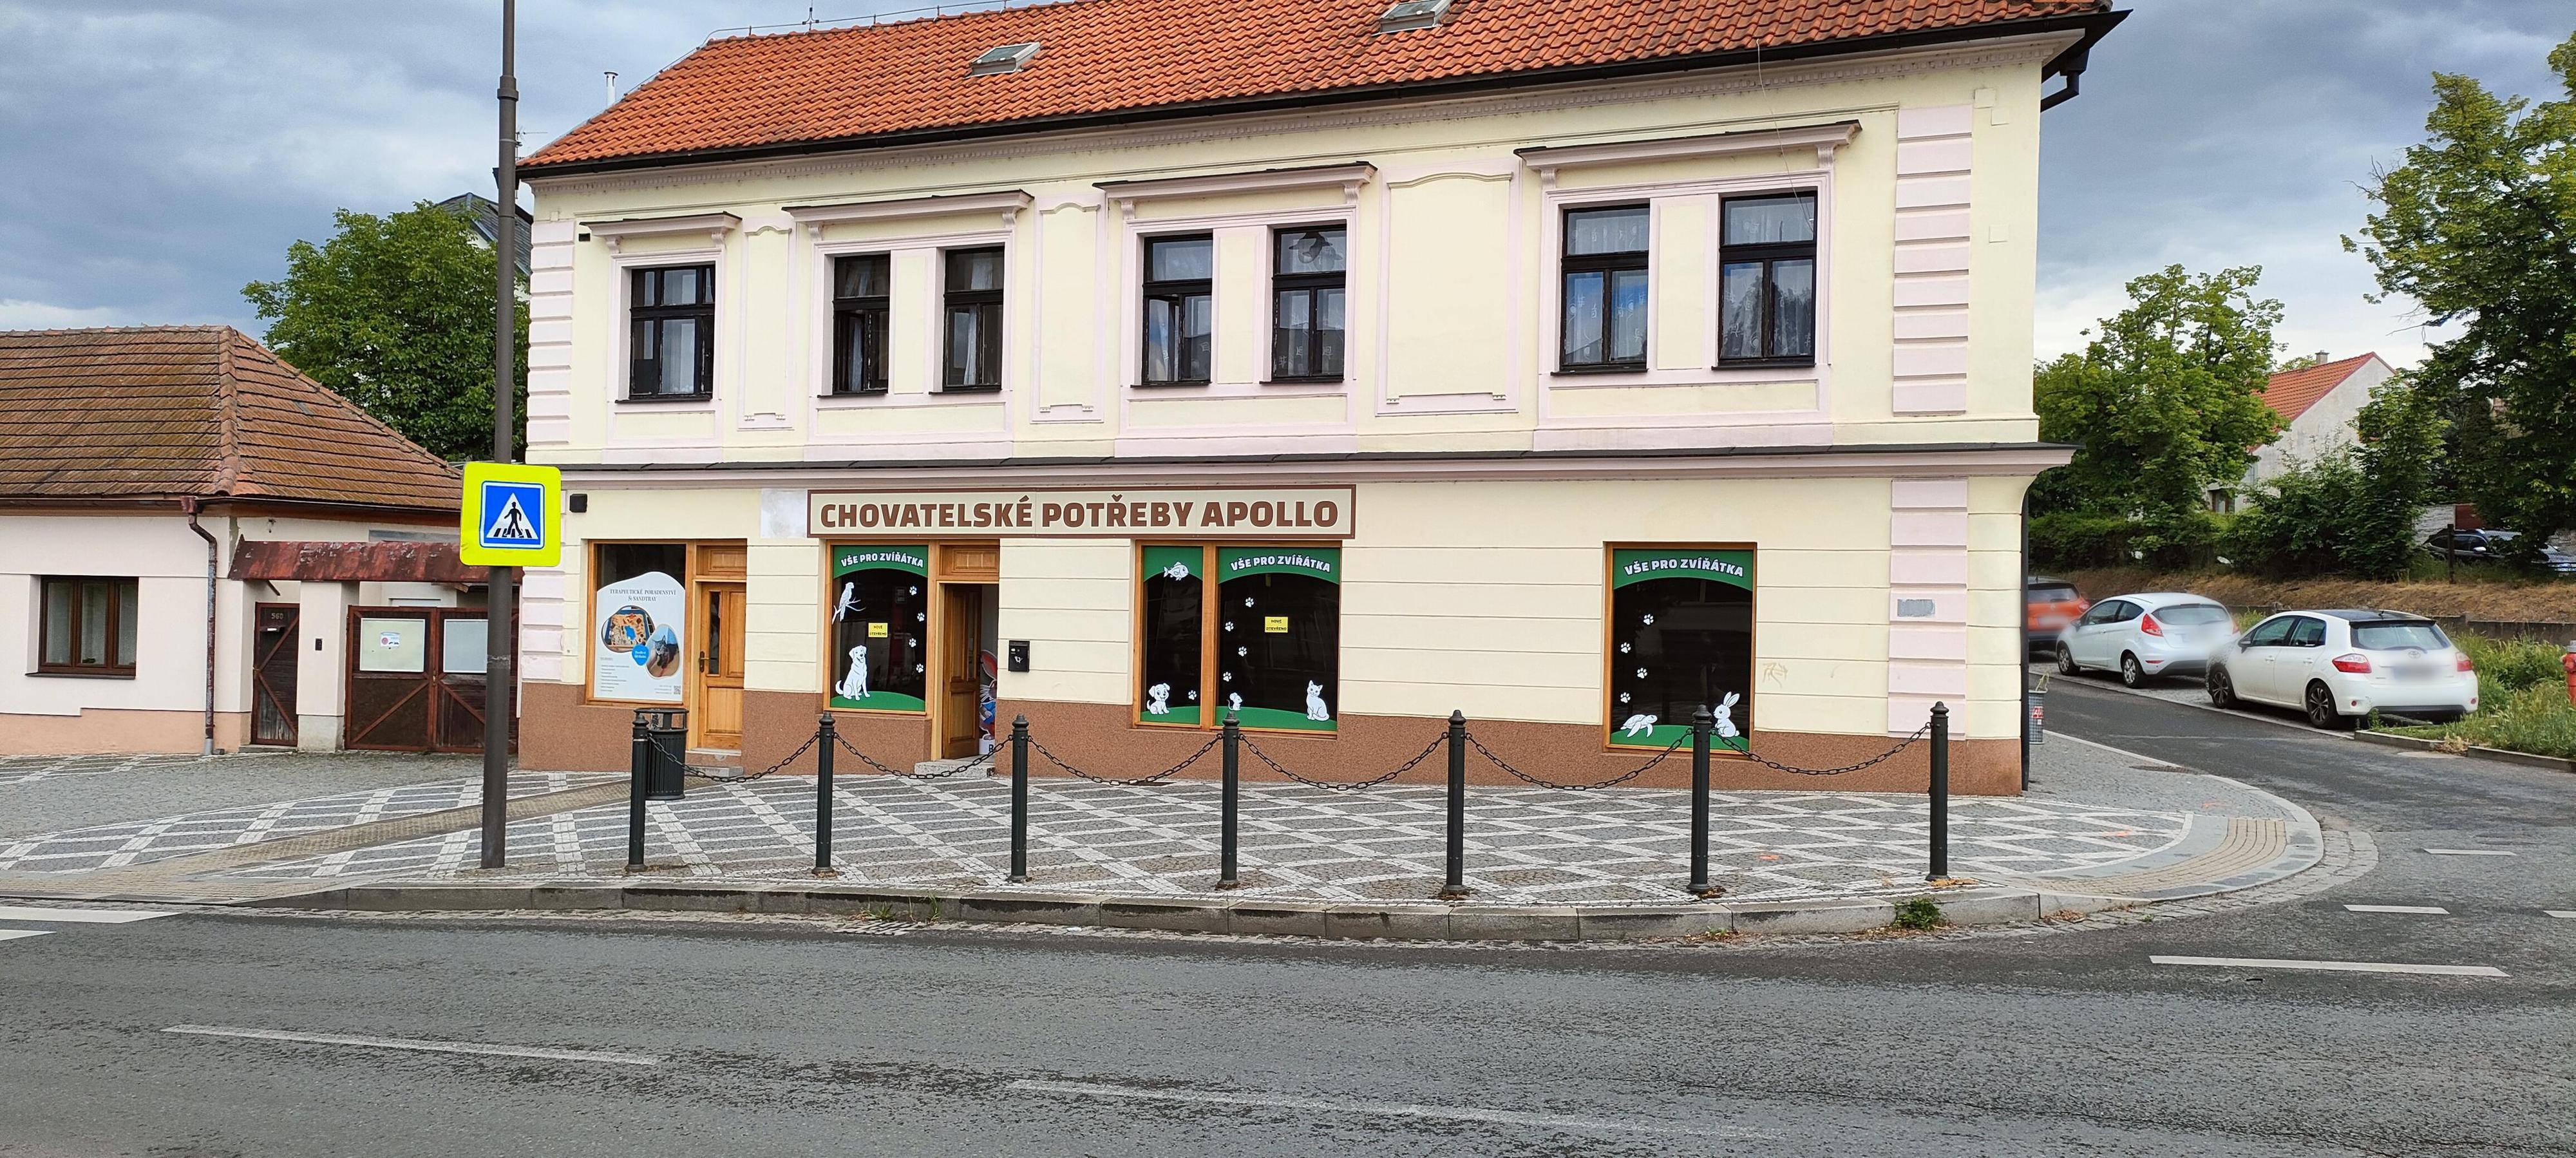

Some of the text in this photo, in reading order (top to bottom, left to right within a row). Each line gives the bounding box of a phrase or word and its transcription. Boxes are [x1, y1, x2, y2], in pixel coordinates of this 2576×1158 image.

[820, 494, 1338, 528] CHOVATELSKÉ POTŘEBY APOLLO
[840, 551, 924, 568] VŠE PRO ZVÍŘÁTKA
[1230, 554, 1331, 573] VŠE PRO ZVÍŘÁTKA
[1624, 556, 1744, 577] VŠE PRO ZVÍŘÁTKA
